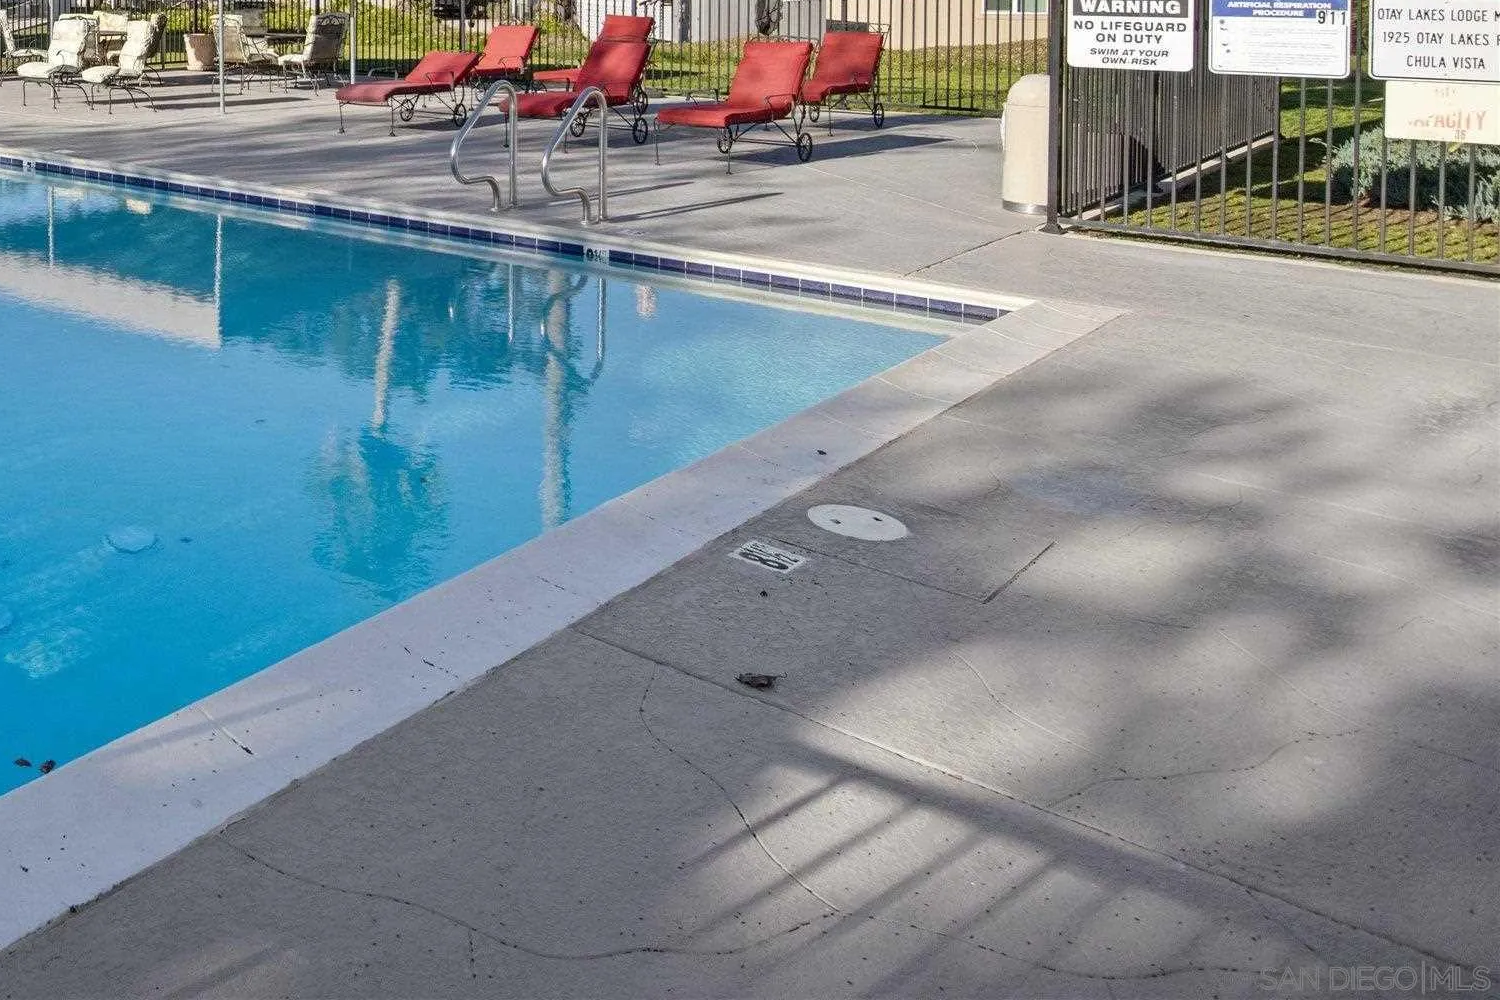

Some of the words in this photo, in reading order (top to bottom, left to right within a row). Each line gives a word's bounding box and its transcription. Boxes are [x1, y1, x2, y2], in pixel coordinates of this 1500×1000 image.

[1080, 0, 1180, 15] WARNING
[1227, 1, 1271, 9] ARTIFICIAL
[1273, 1, 1332, 10] RESPIRATION
[1252, 9, 1304, 17] PROCEDURE
[1317, 10, 1347, 25] 911
[1377, 7, 1403, 20] OTAY
[1408, 8, 1445, 21] LAKES
[1451, 9, 1488, 22] LODGE
[1074, 20, 1094, 30] NO
[1101, 21, 1187, 32] LIFEGUARD
[1096, 33, 1116, 43] ON
[1124, 34, 1162, 44] DUTY
[1383, 31, 1410, 44] 1925
[1416, 32, 1444, 44] OTAY
[1450, 33, 1489, 46] LAKES
[1090, 47, 1118, 56] SWIM
[1139, 49, 1169, 58] YOUR
[1102, 57, 1127, 65] OWN
[1131, 58, 1157, 66] RISK
[1406, 55, 1447, 68] CHULA
[1452, 56, 1486, 69] VISTA
